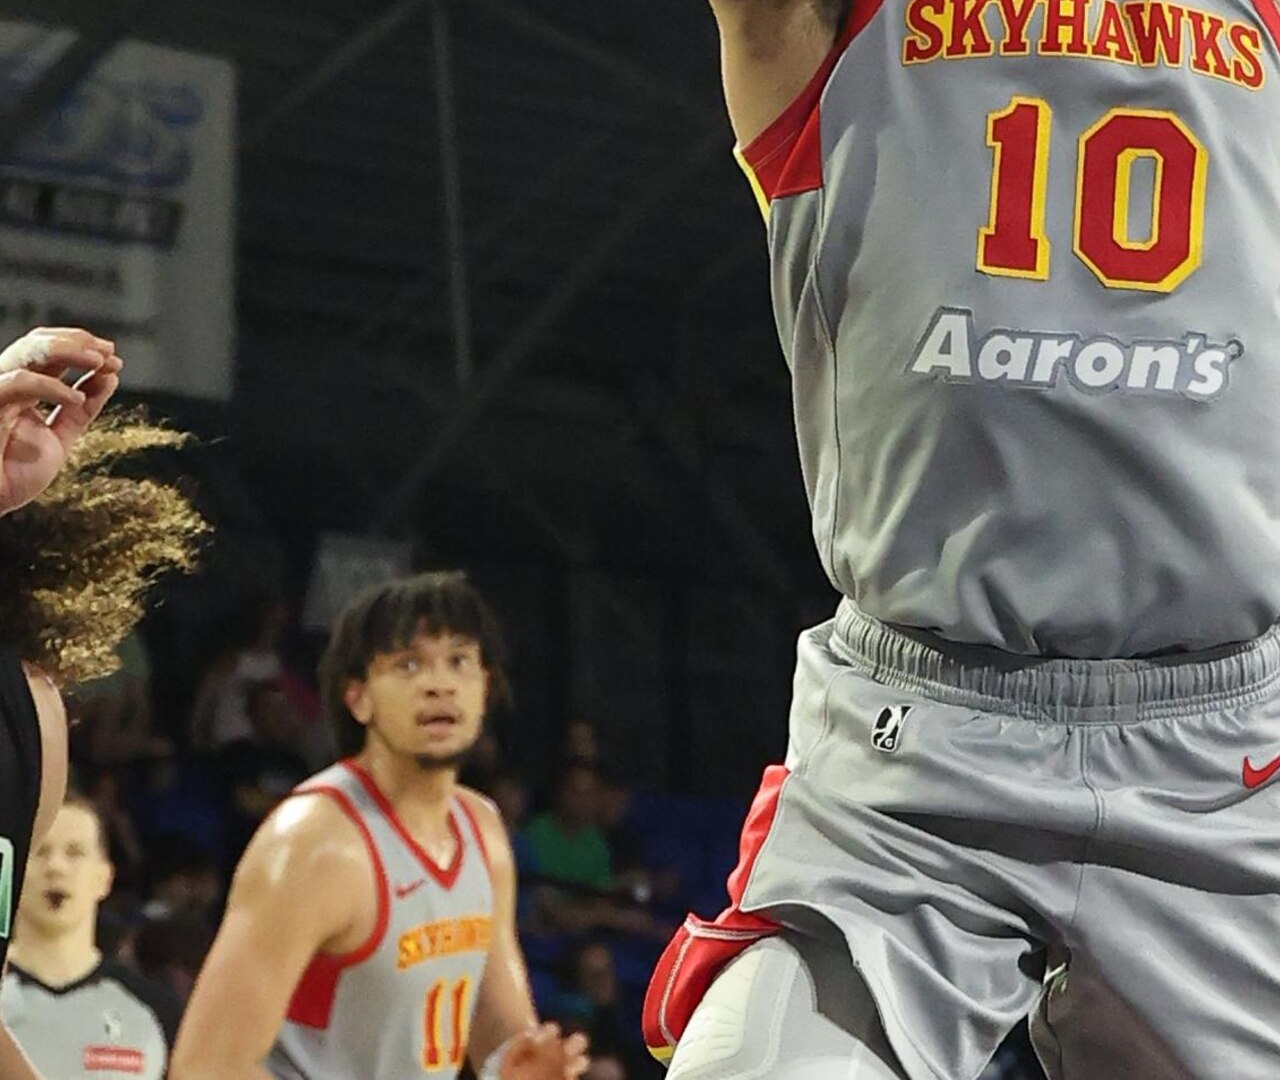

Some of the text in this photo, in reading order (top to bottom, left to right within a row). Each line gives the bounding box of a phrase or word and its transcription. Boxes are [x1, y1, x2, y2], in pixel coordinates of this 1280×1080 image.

[976, 96, 1208, 294] 10
[911, 313, 1226, 396] Aaron's
[424, 977, 470, 1069] 11
